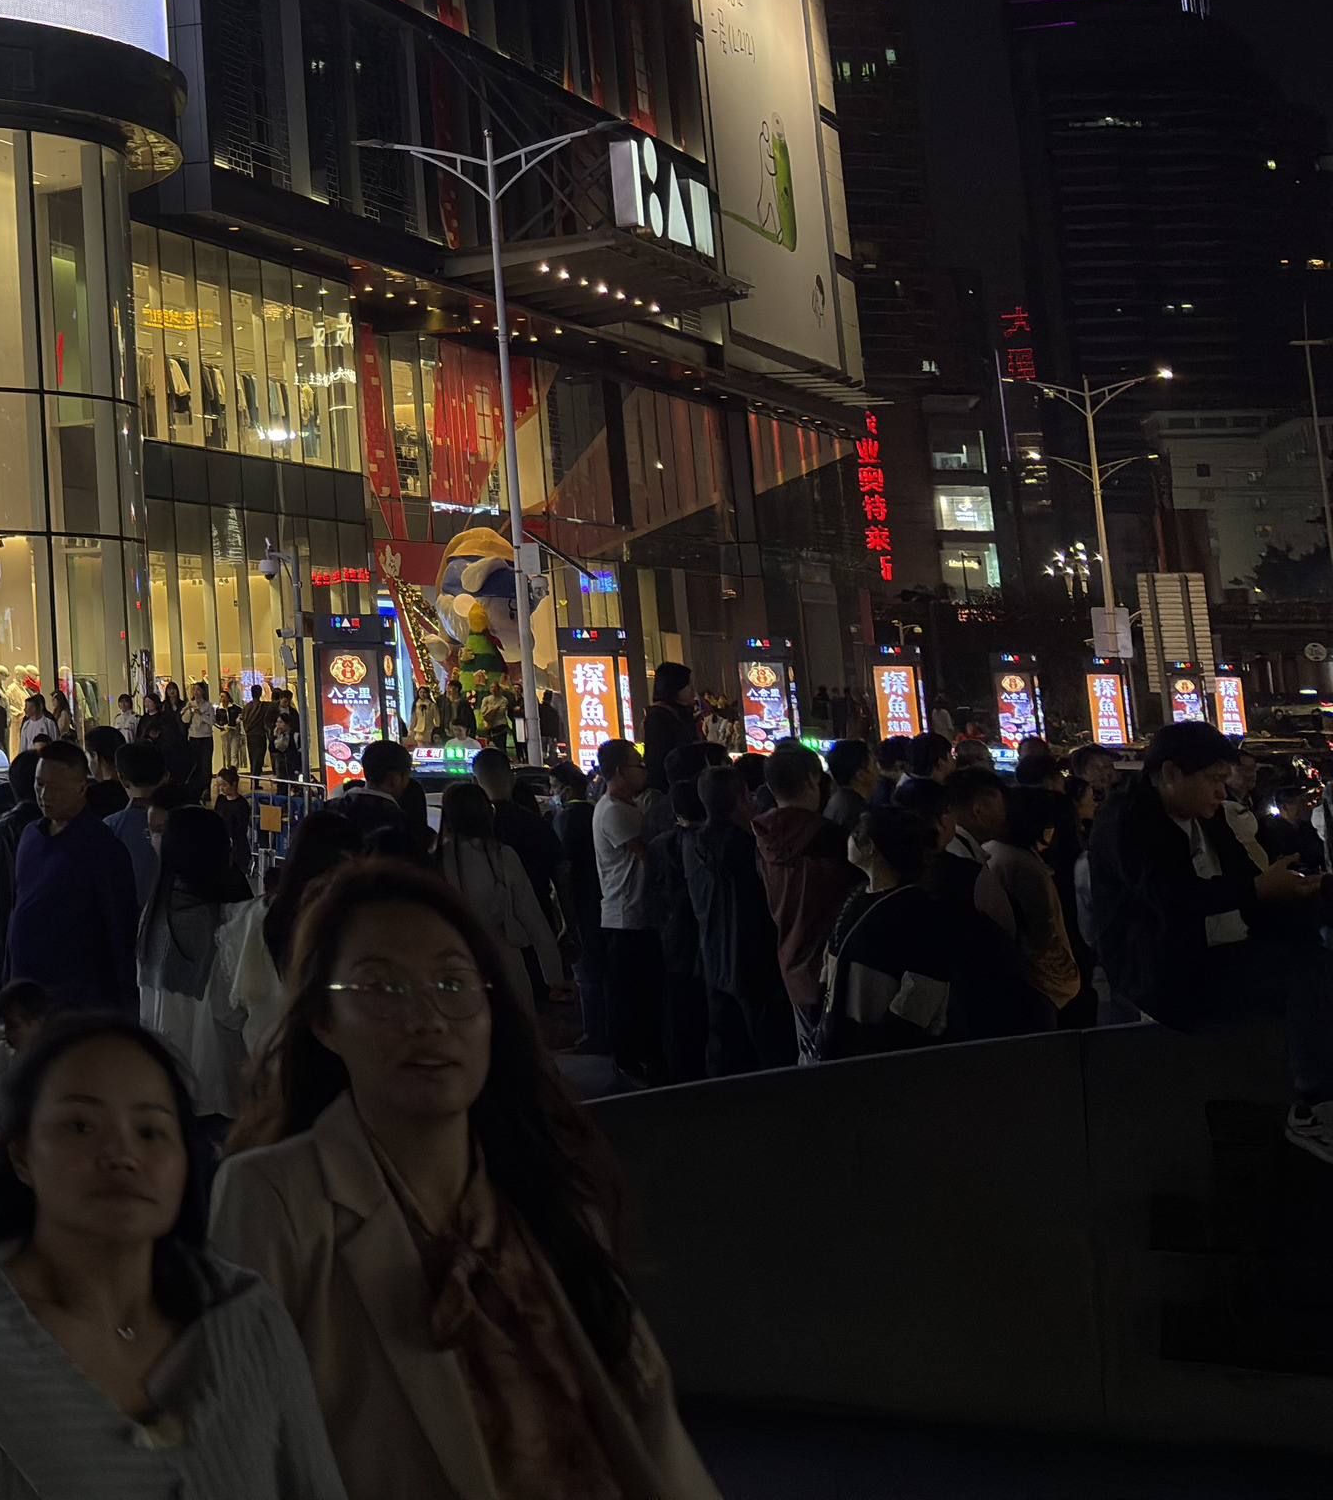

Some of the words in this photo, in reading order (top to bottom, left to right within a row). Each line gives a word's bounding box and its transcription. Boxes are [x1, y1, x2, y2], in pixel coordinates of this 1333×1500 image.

[327, 687, 372, 699] 八合里
[746, 687, 782, 699] 八合里
